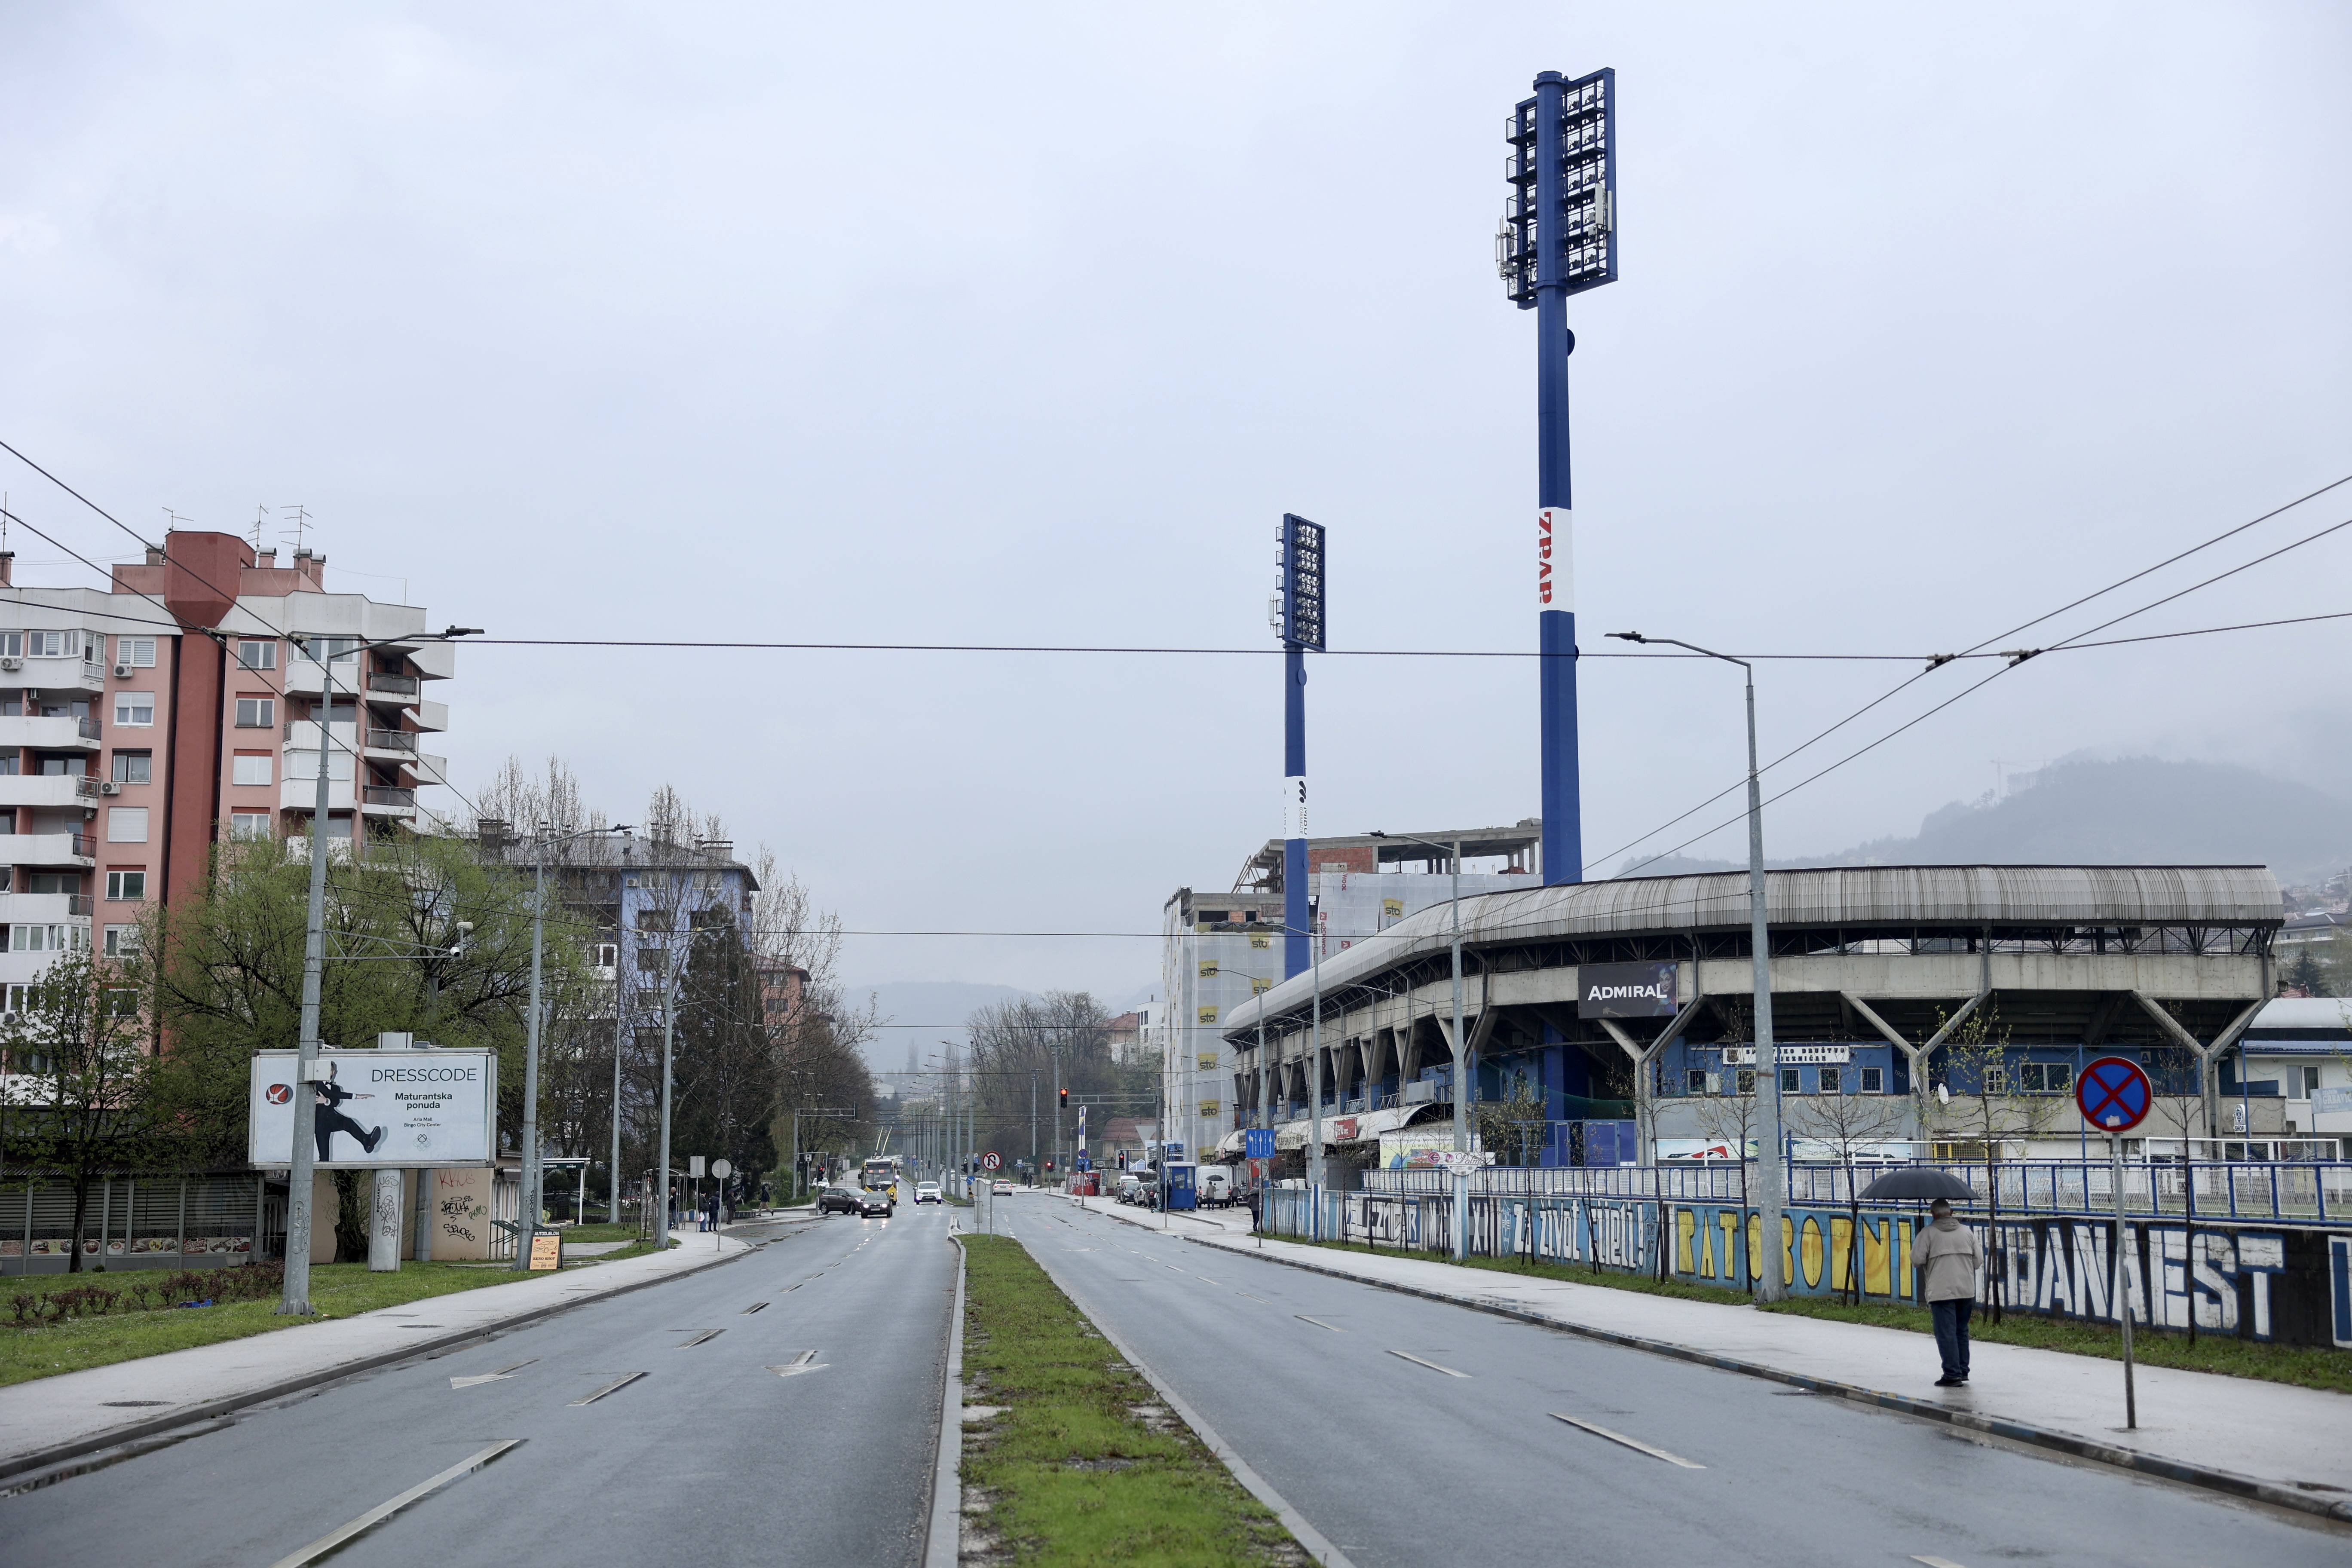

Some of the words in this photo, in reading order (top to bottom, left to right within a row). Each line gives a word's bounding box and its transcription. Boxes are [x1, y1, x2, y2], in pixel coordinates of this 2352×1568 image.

[1385, 905, 1400, 916] sto
[1252, 938, 1268, 948] sto
[1588, 983, 1667, 1001] ADMIRAL
[1200, 1013, 1216, 1023] sto
[2141, 1053, 2150, 1061] A
[1200, 1060, 1216, 1069] sto
[372, 1068, 477, 1082] DRESSCODE
[1894, 1070, 1907, 1079] 1921
[395, 1092, 453, 1100] Maturantska
[407, 1101, 441, 1110] ponuda
[1201, 1106, 1217, 1116] sto
